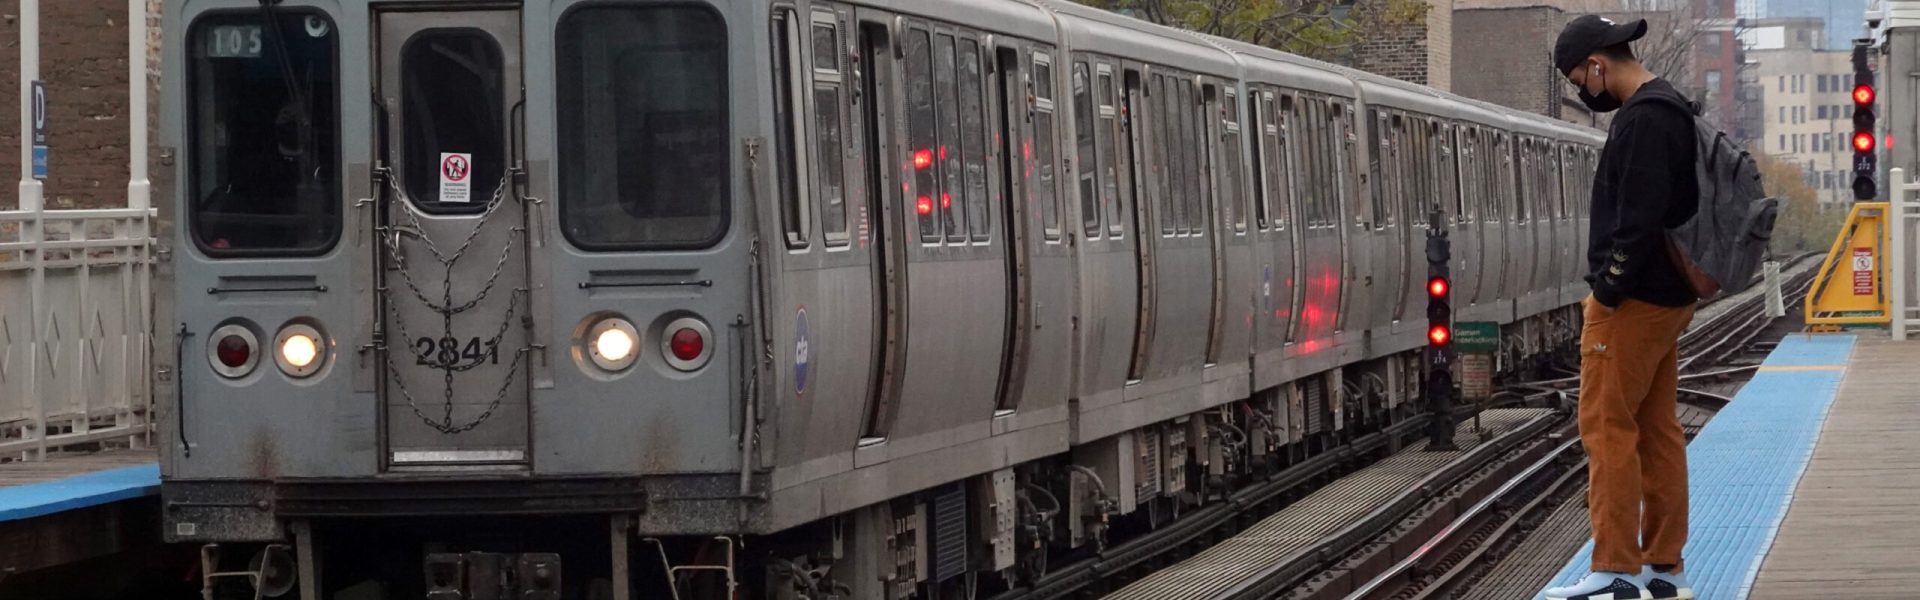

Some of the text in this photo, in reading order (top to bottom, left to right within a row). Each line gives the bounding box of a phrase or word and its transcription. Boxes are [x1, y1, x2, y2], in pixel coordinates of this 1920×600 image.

[214, 28, 261, 54] 105
[35, 85, 45, 129] D
[416, 336, 499, 365] 2841
